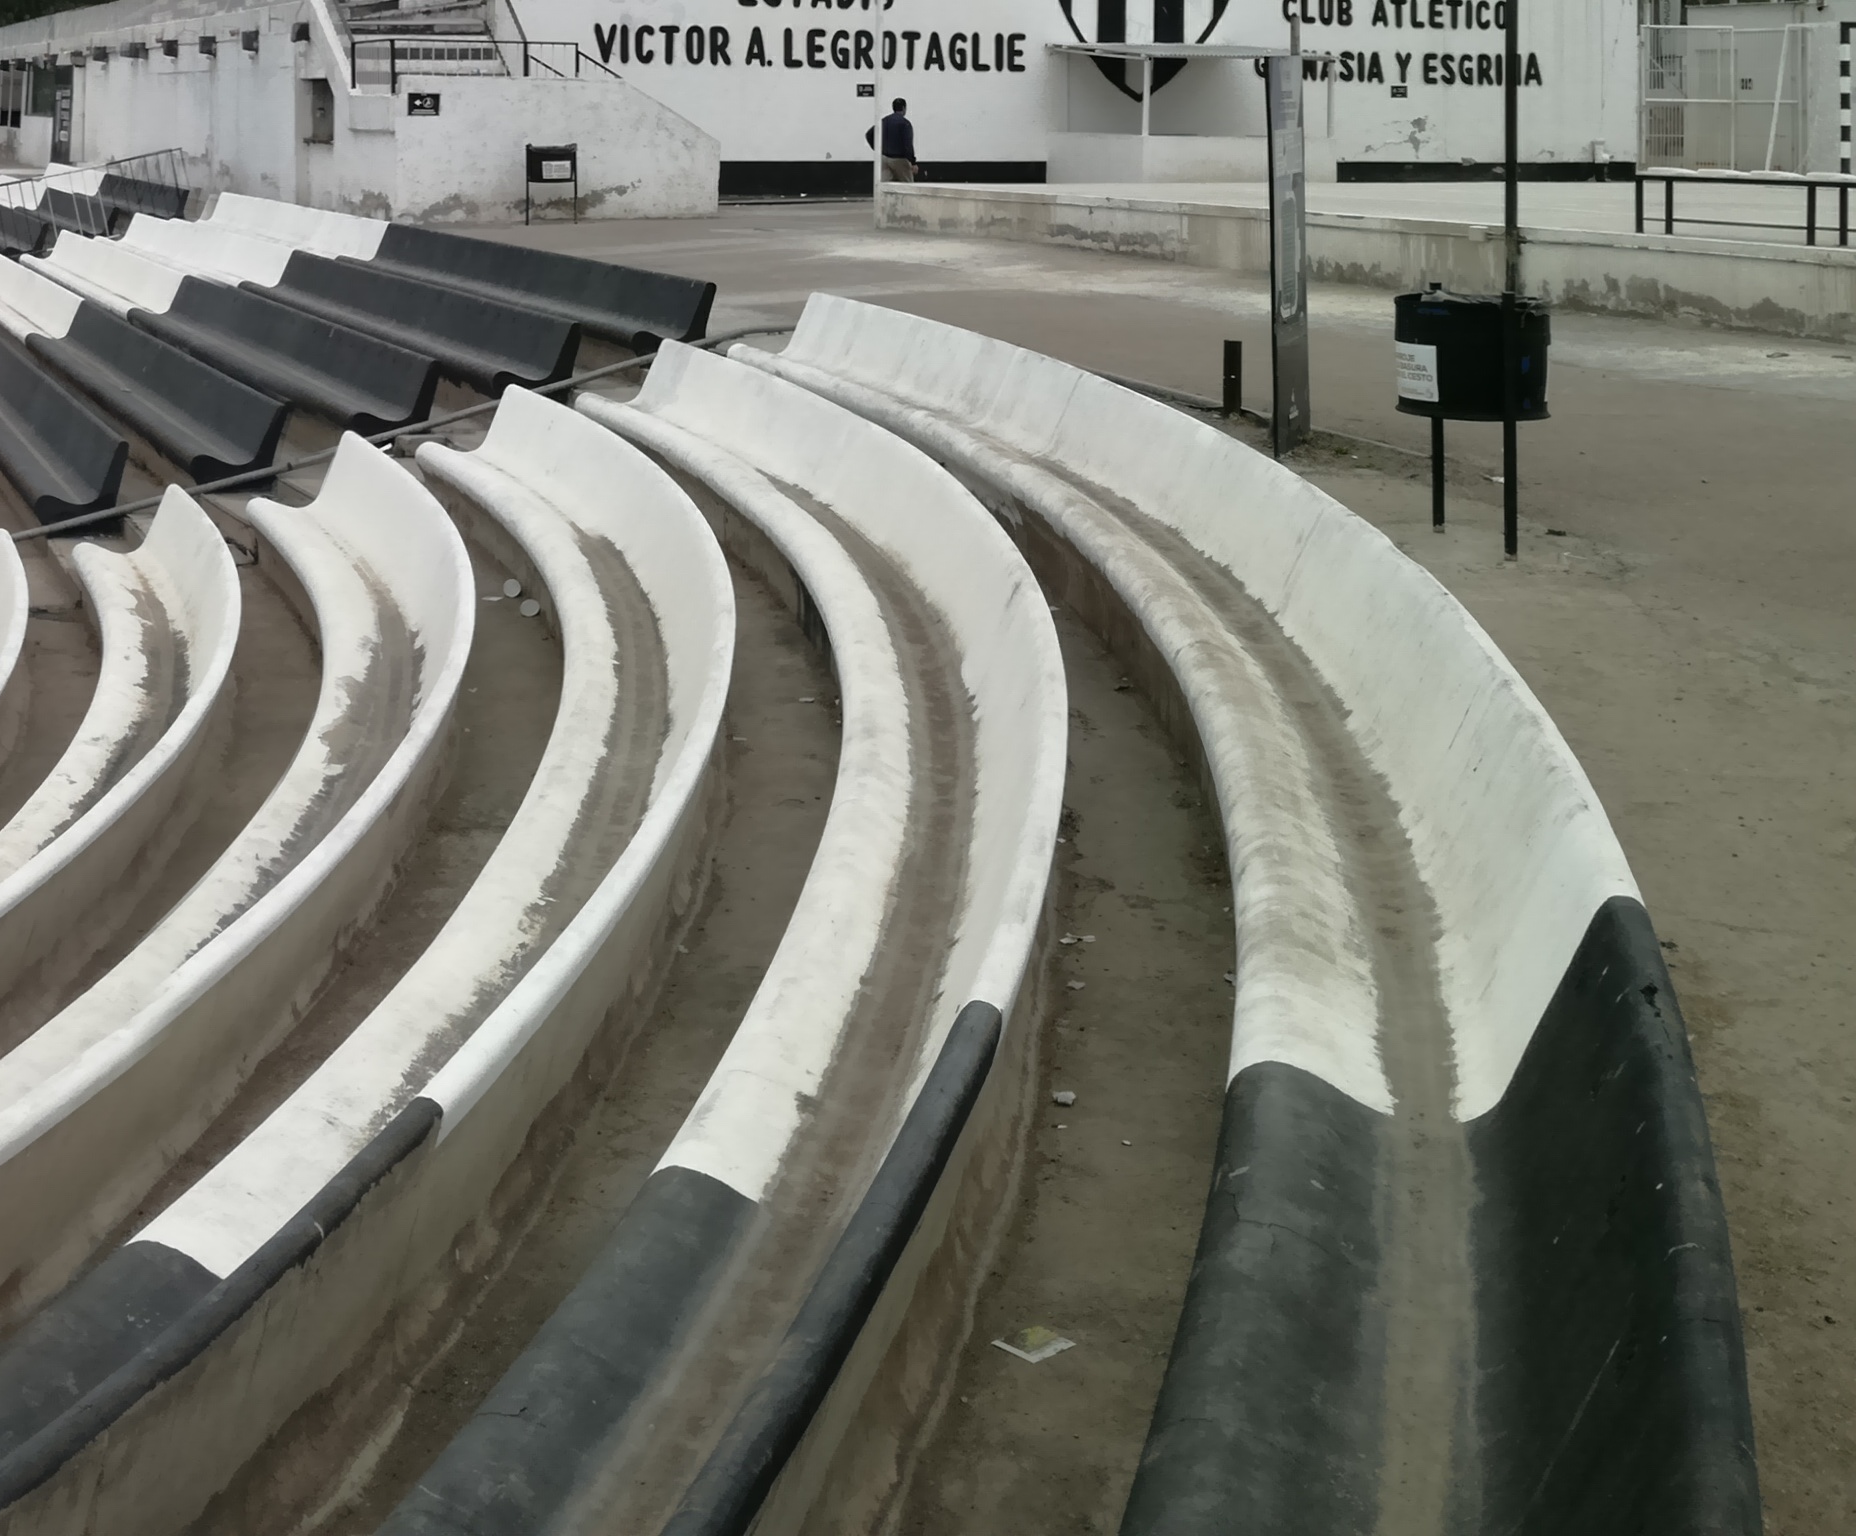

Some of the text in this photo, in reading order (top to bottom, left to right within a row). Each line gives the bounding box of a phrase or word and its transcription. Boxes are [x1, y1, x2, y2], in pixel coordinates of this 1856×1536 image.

[594, 22, 1027, 72] VICTOR A. LEGROTAGLIE
[1395, 52, 1413, 83] Y
